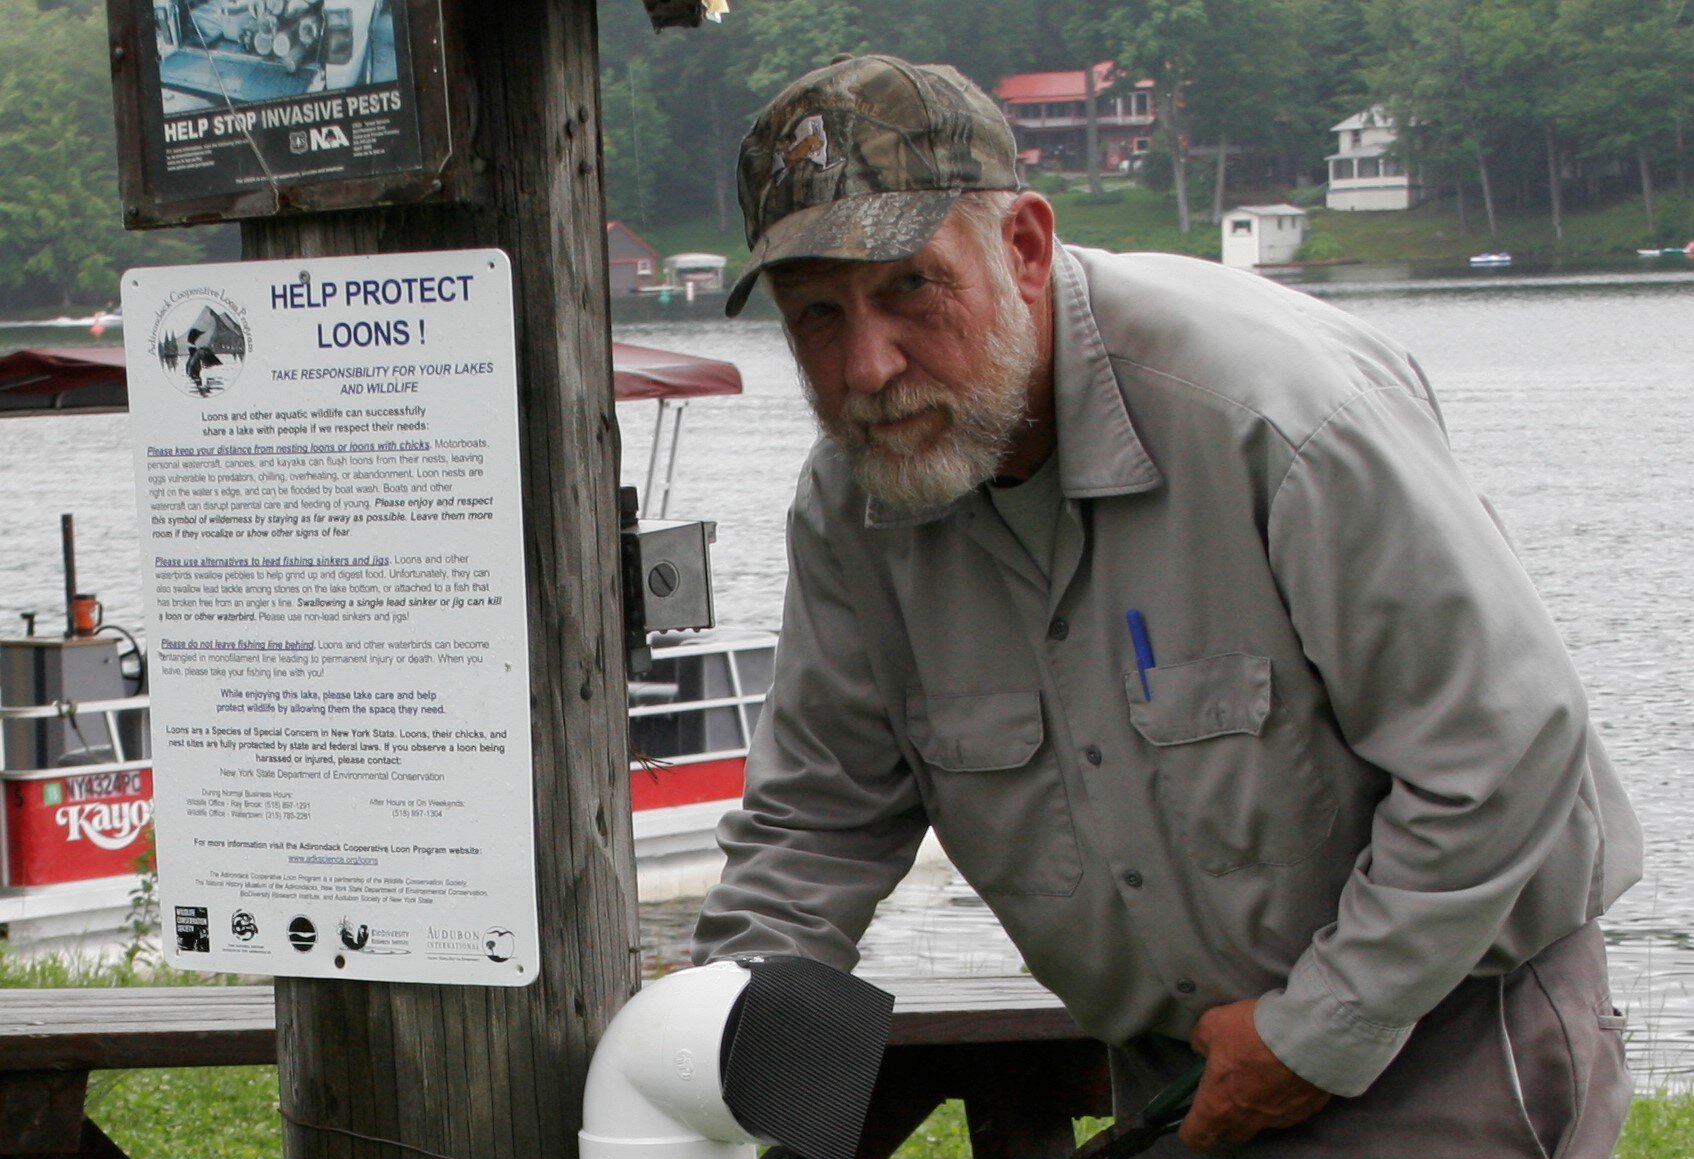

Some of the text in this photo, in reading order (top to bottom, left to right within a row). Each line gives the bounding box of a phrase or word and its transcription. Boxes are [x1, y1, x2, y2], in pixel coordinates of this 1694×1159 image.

[164, 118, 209, 142] HELP
[214, 111, 256, 135] STOP
[261, 98, 343, 129] INVASIVE
[345, 90, 401, 116] PESTS
[169, 287, 219, 302] Cooperative
[271, 275, 474, 309] HELP PROTECT
[316, 320, 410, 349] LOONS
[271, 362, 494, 381] TAKE RESPONSIBILITY FOR YOUR LAKES
[340, 381, 418, 395] AND WILDLIFE
[201, 406, 425, 421] Loons and other aquatic wildlife can successfully
[202, 427, 226, 435] share
[235, 426, 253, 434] lake
[256, 425, 274, 434] with
[277, 424, 307, 434] people
[310, 423, 316, 432] if
[334, 422, 369, 433] respect
[371, 422, 392, 431] their
[374, 496, 493, 508] Please enjoy and respect
[220, 689, 242, 697] While
[245, 690, 280, 700] enjoying
[282, 690, 297, 698] this
[322, 690, 350, 700] please
[353, 690, 372, 699] take
[396, 691, 414, 699] and
[416, 690, 436, 701] help
[55, 799, 154, 850] Kayo
[427, 926, 480, 940] AUDUBON
